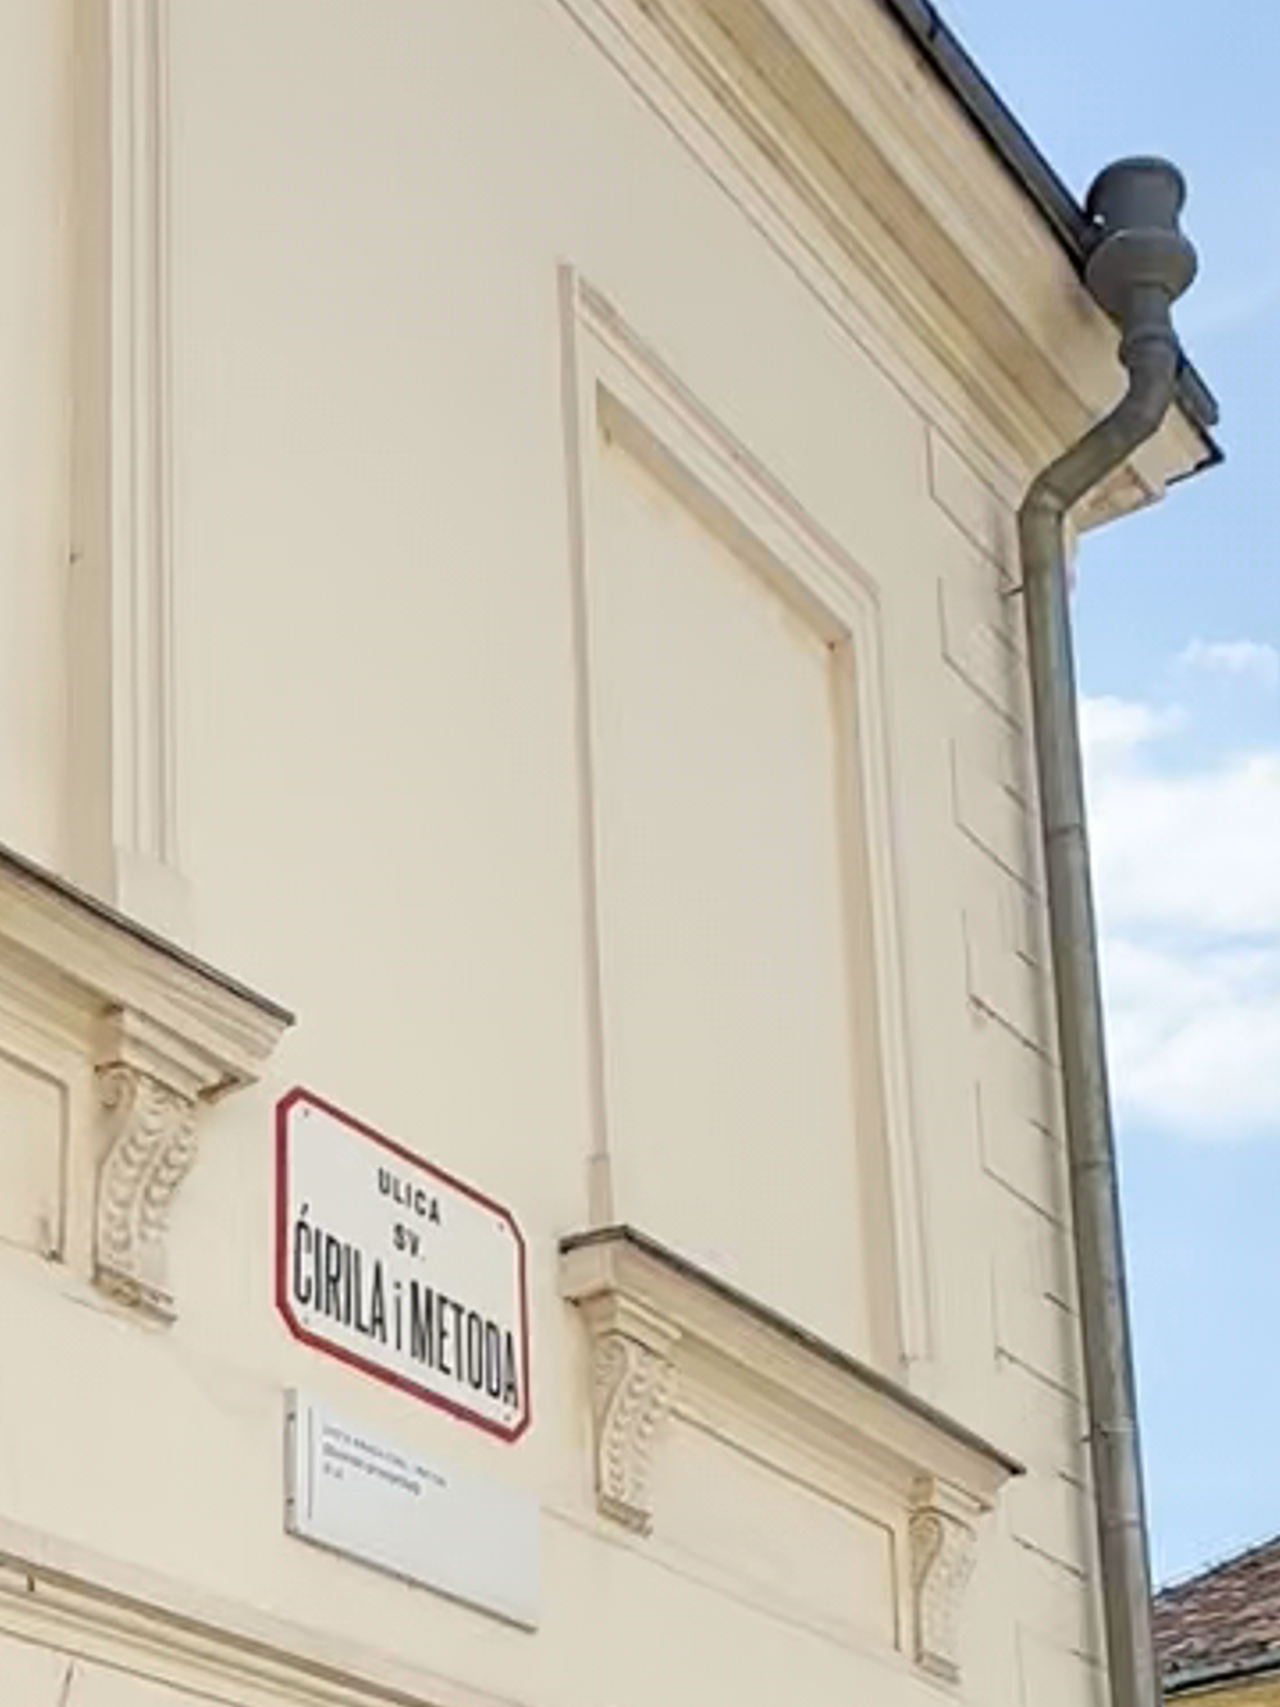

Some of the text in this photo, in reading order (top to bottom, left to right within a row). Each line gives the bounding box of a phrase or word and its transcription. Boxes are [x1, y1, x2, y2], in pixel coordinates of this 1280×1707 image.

[378, 1167, 440, 1225] ULICA
[393, 1223, 425, 1261] SV.
[294, 1203, 387, 1344] ĆIRILA
[410, 1280, 518, 1410] METODA
